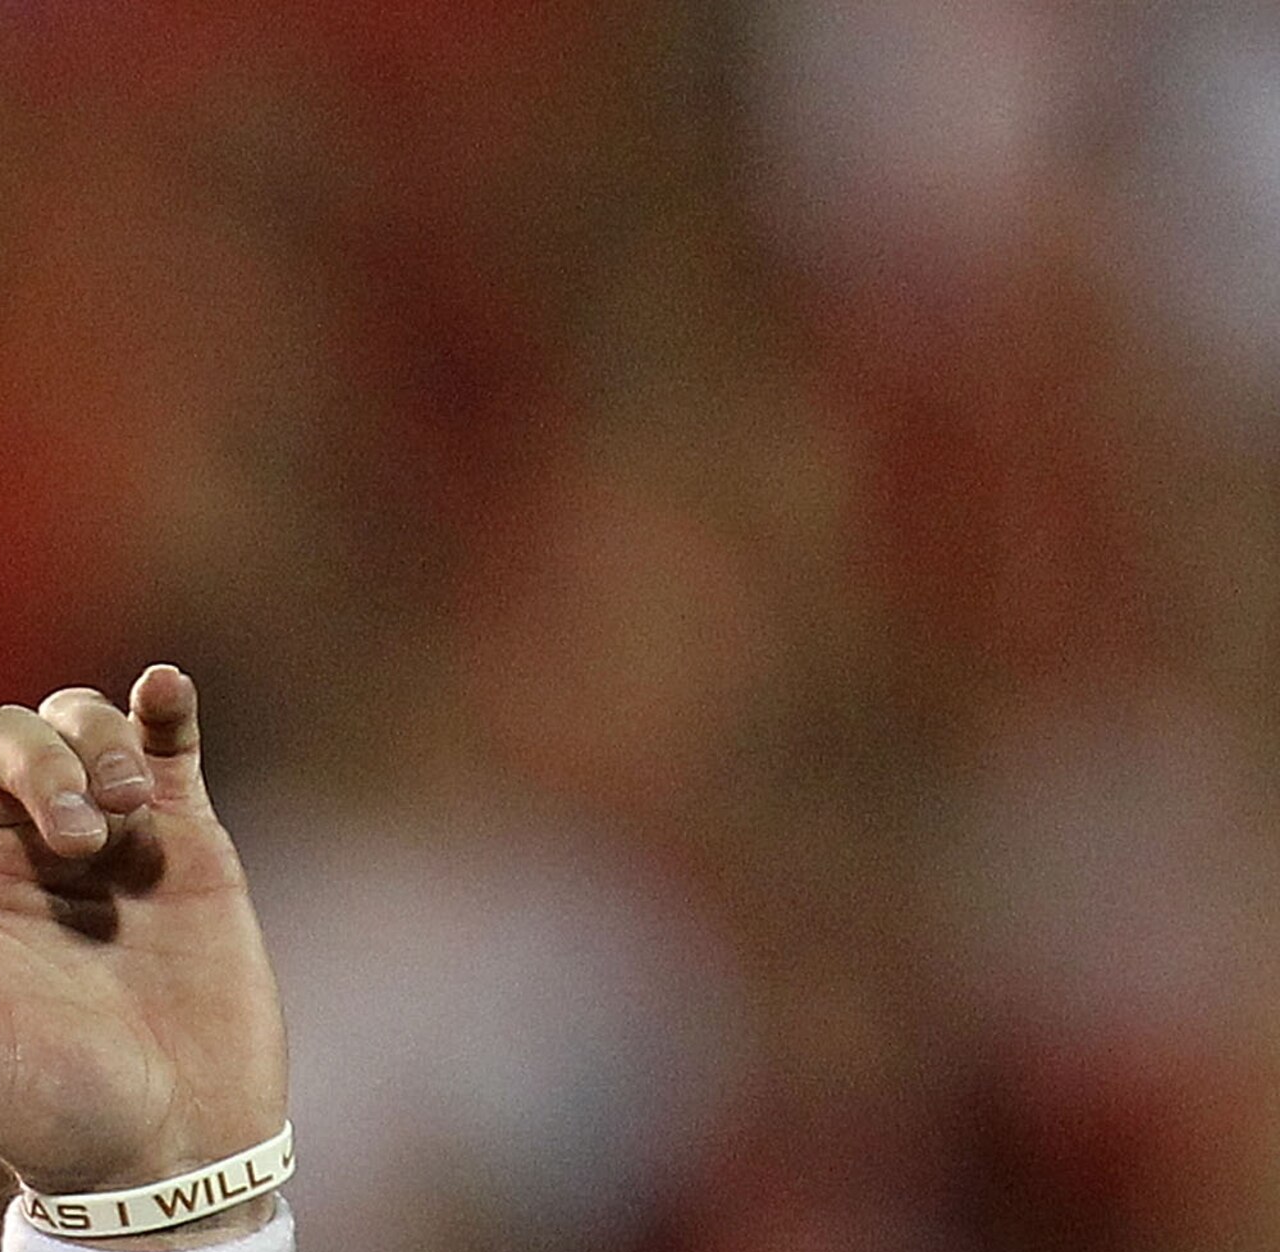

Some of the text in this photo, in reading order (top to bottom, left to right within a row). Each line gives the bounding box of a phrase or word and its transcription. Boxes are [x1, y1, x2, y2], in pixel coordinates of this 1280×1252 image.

[30, 1161, 274, 1229] AS I WILL
